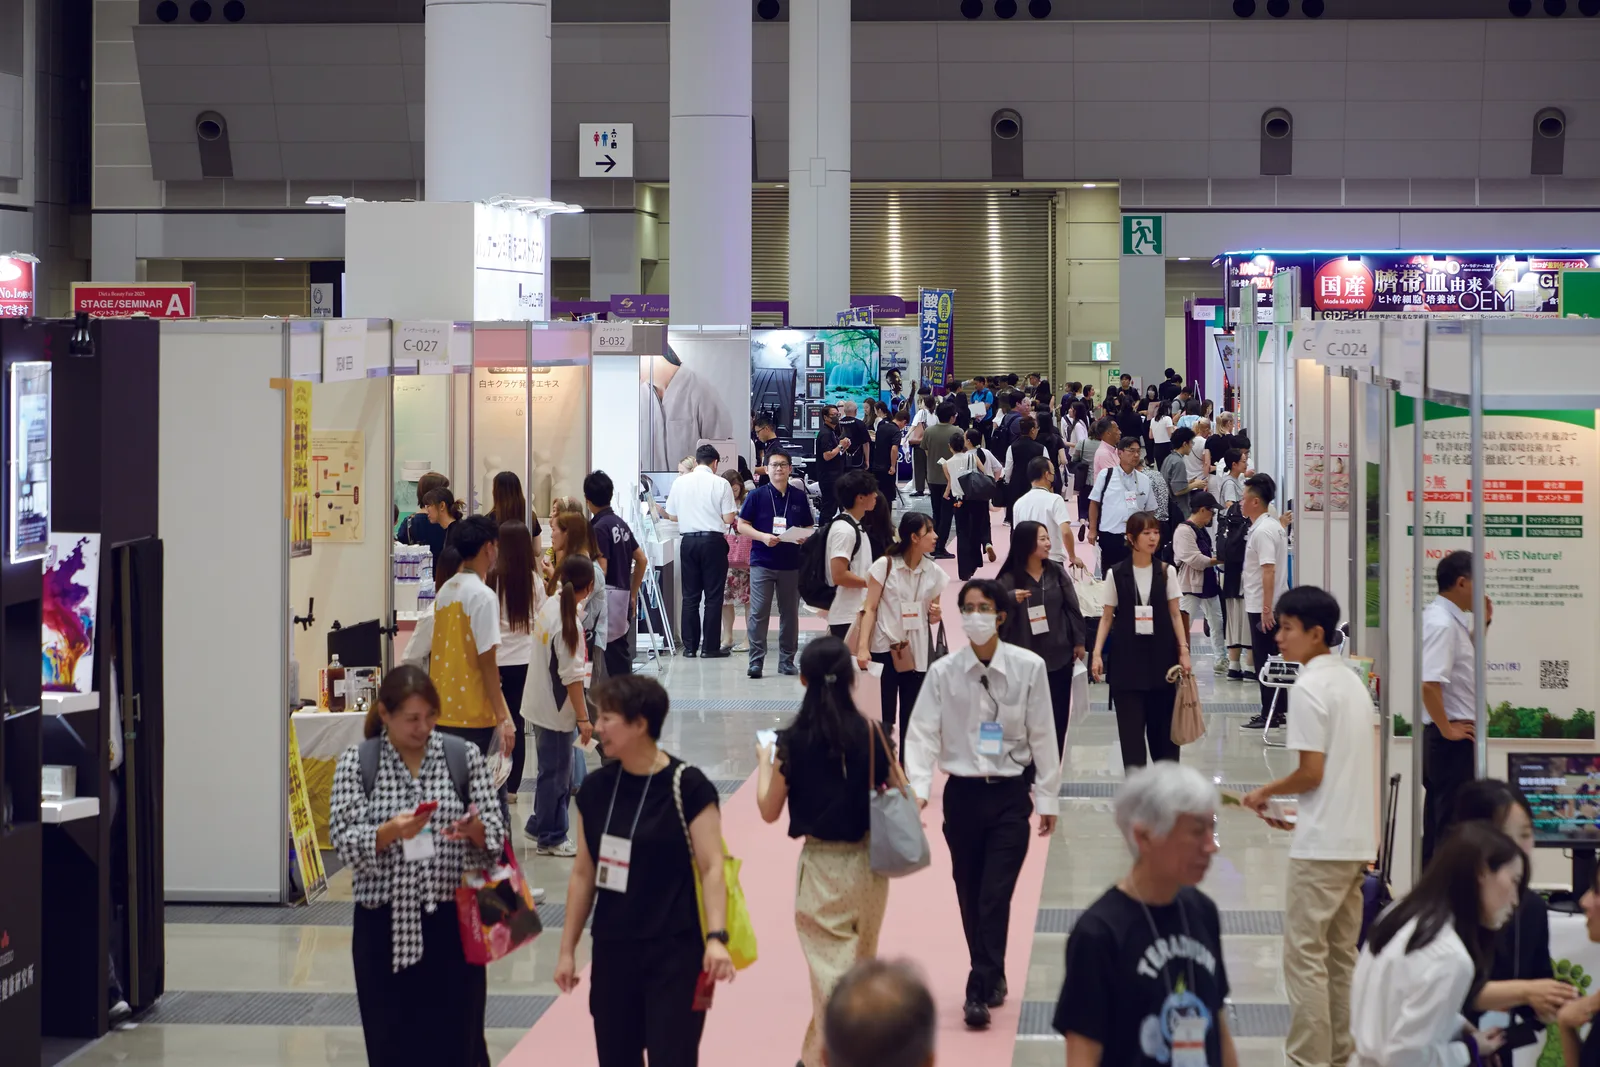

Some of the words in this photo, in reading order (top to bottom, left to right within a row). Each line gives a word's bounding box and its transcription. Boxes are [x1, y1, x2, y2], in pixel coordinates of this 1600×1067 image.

[1321, 275, 1366, 297] 国産
[80, 299, 163, 309] STAGE/SEMINAR
[165, 293, 186, 316] A
[1378, 294, 1422, 304] ヒト幹細胞
[1426, 294, 1456, 304] 培養液
[1457, 289, 1514, 311] OEM
[1323, 310, 1366, 320] GDF-11
[403, 339, 438, 353] C-027
[599, 336, 625, 347] B-032
[1326, 342, 1368, 357] C-024
[1425, 549, 1442, 559] NO
[1499, 550, 1520, 560] YES
[1522, 550, 1562, 560] Nature!
